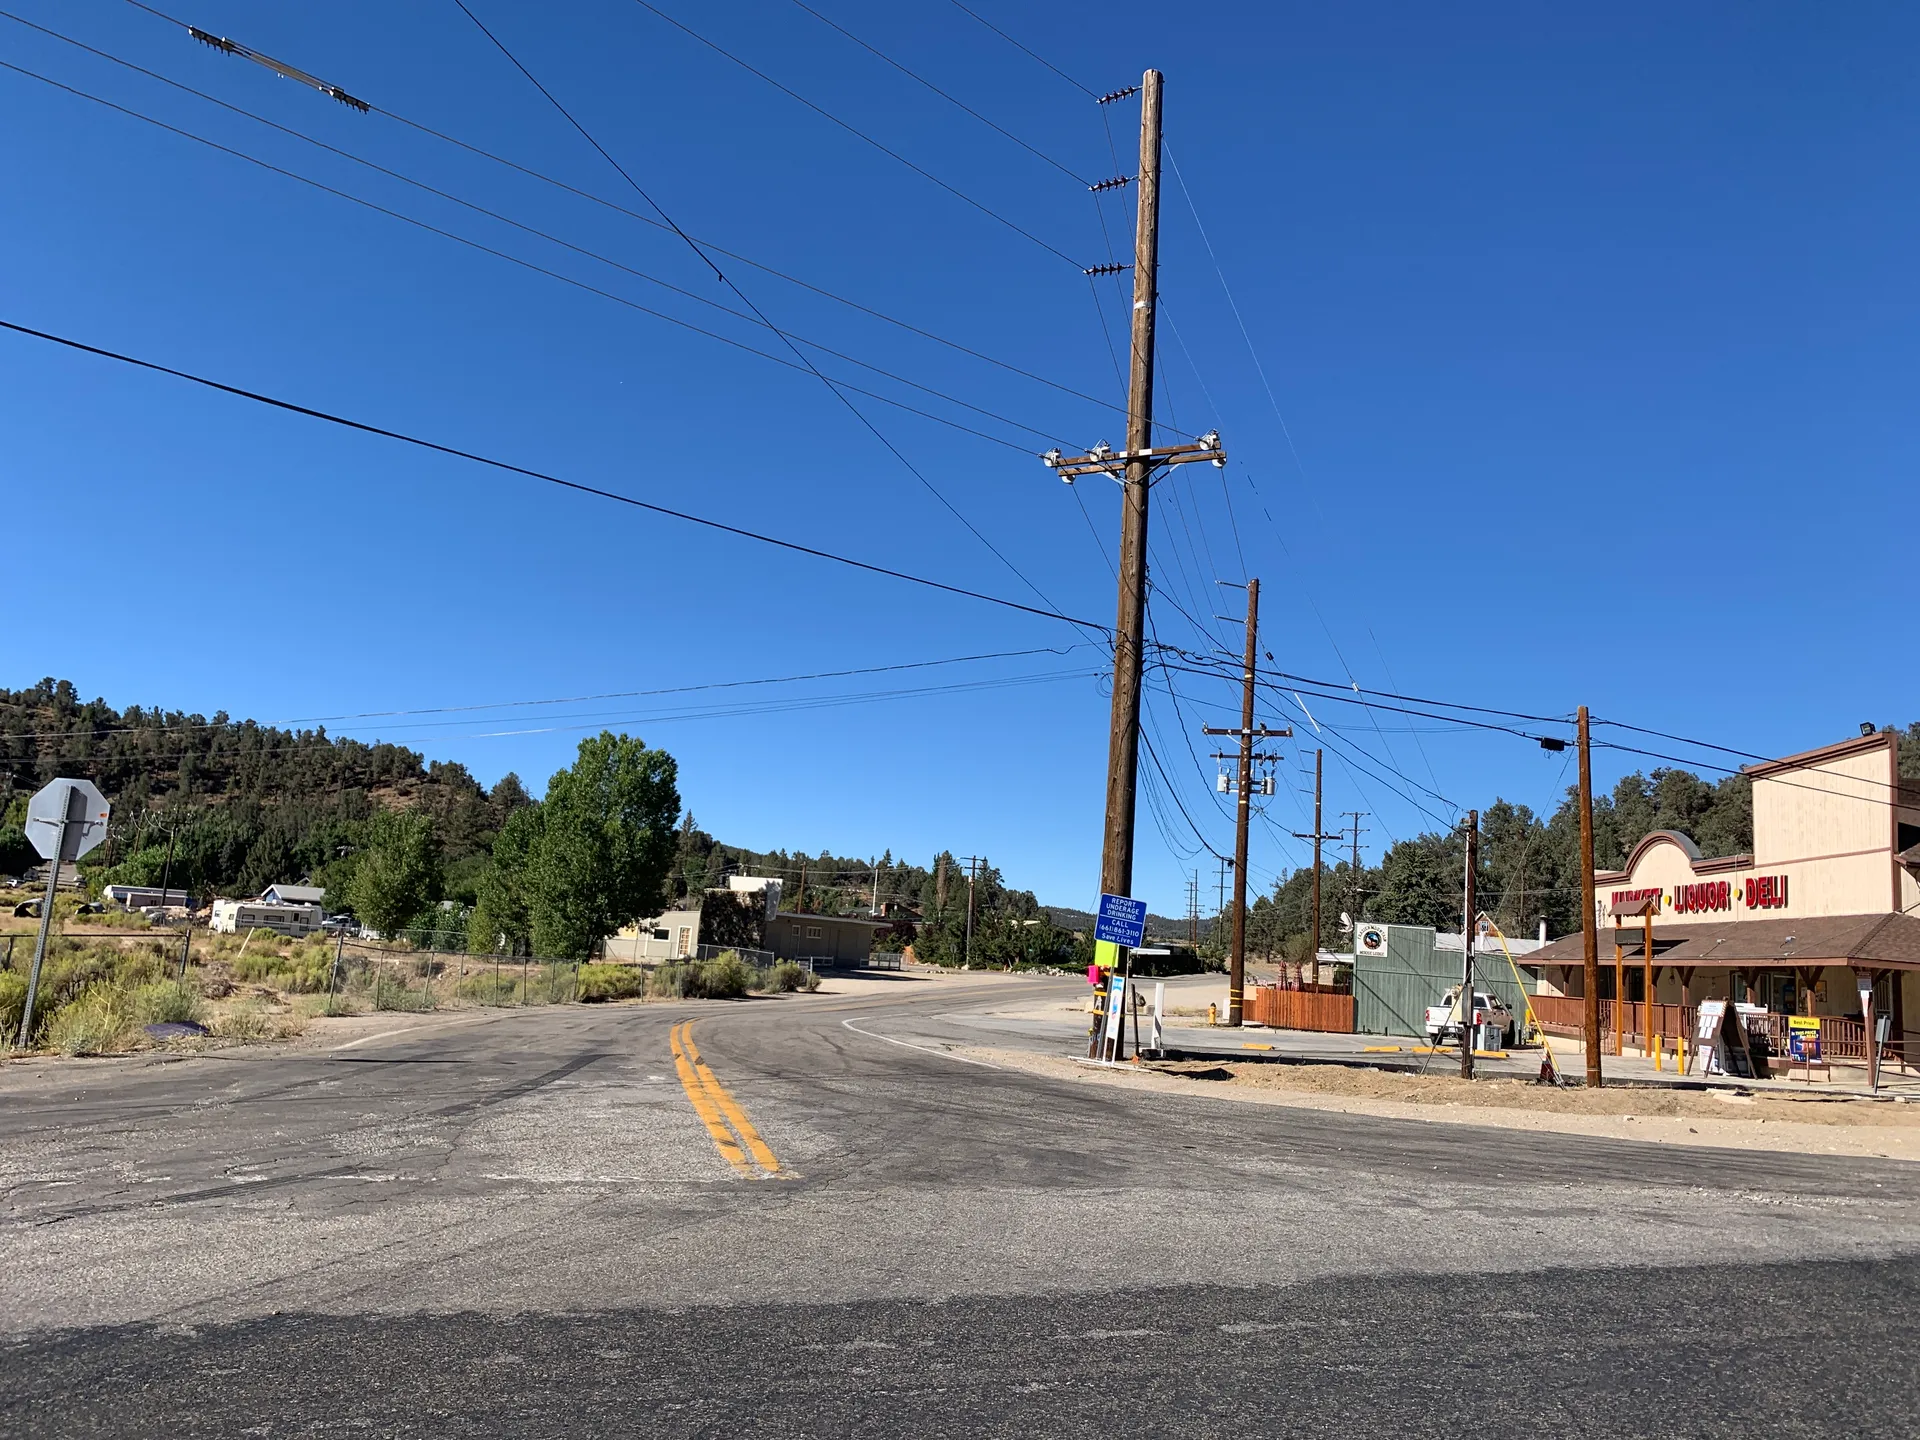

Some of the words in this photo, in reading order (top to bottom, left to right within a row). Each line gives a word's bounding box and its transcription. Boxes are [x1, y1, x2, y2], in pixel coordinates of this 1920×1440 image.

[1674, 880, 1731, 914] LIQUOR
[1745, 875, 1788, 910] DELI
[1111, 898, 1136, 907] REPORT
[1106, 903, 1139, 915] UNDERAGE
[1107, 909, 1136, 920] DRINKING
[1111, 919, 1128, 928] CALL
[1101, 932, 1115, 940] Save
[1116, 936, 1133, 944] Lives
